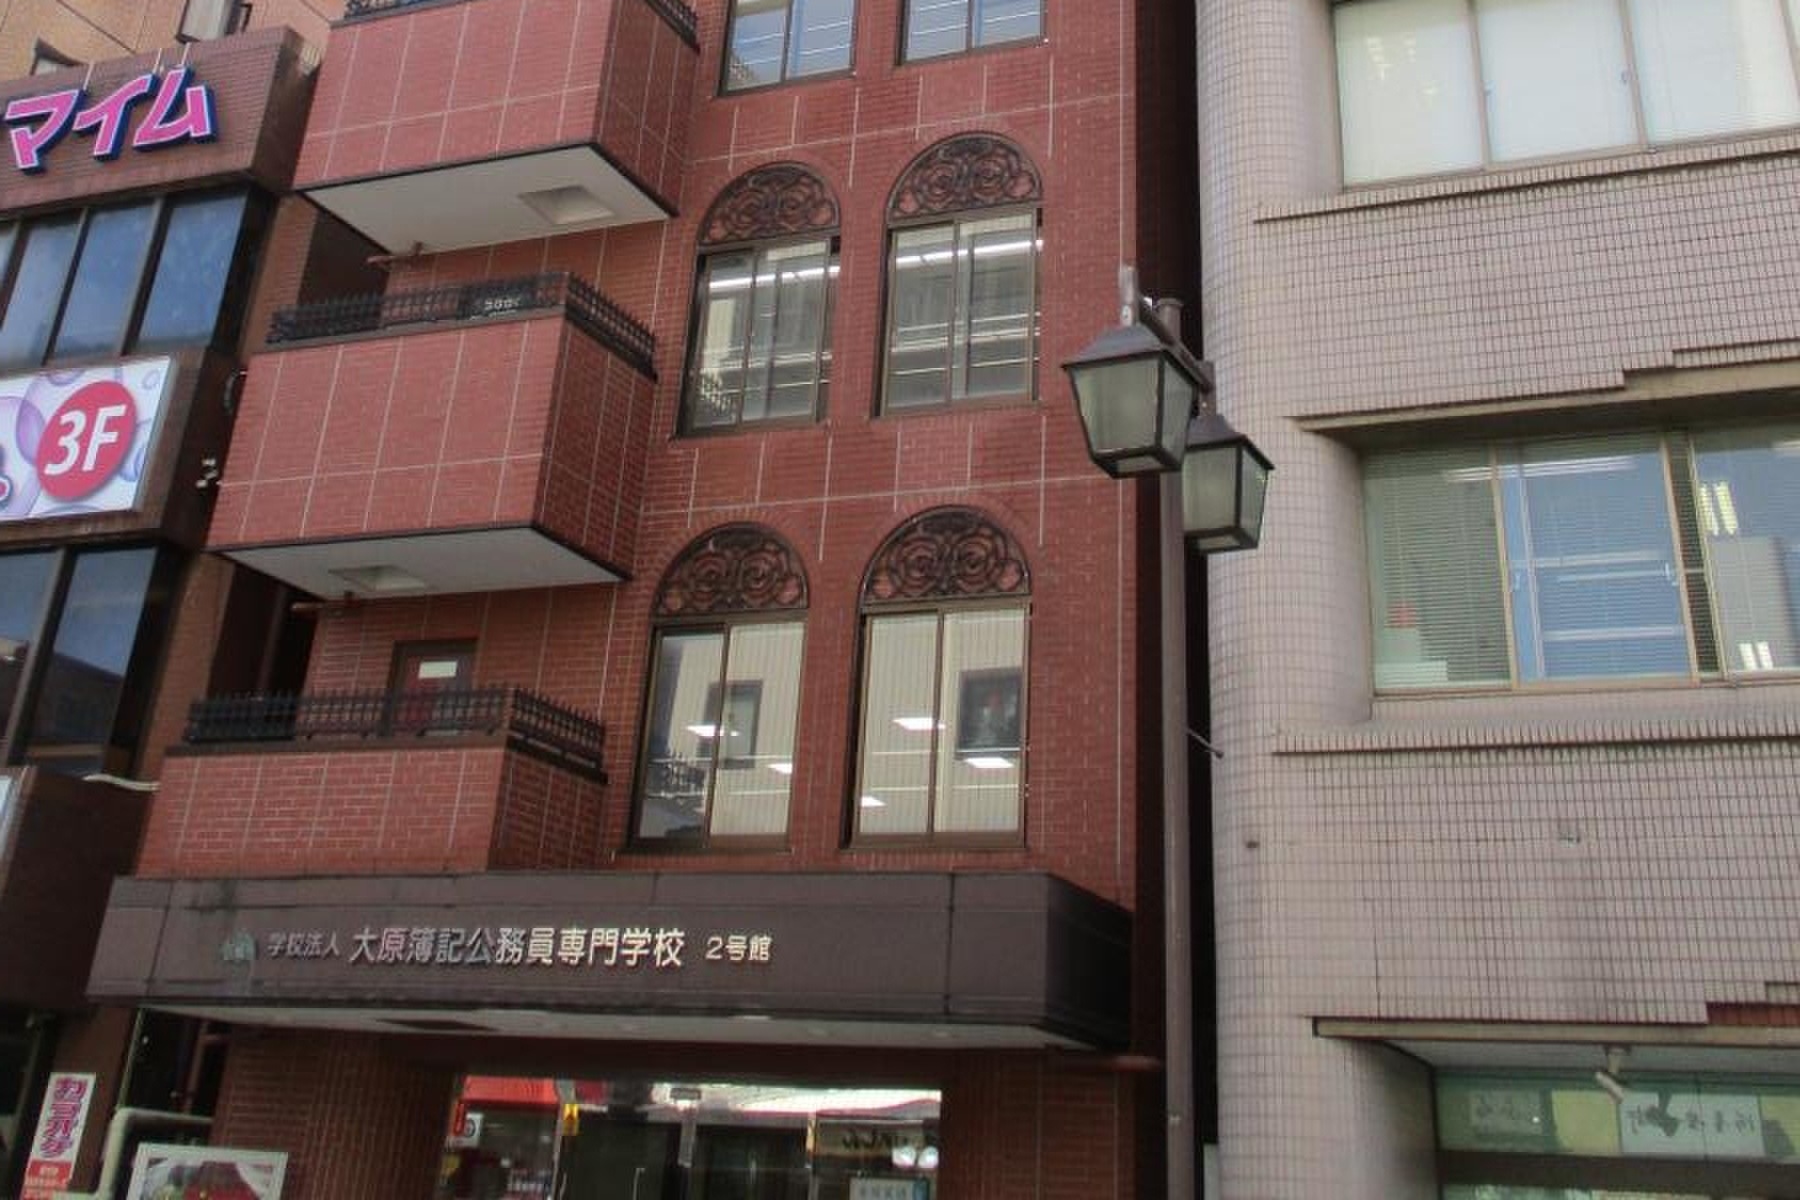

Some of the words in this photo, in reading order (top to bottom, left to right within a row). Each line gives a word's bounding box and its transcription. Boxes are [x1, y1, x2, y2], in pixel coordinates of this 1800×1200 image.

[5, 65, 216, 174] マイム
[44, 404, 127, 476] 3F
[268, 932, 340, 958] 学校法人
[350, 926, 686, 967] 大原簿記公務員専門学校
[705, 935, 772, 962] 2号館
